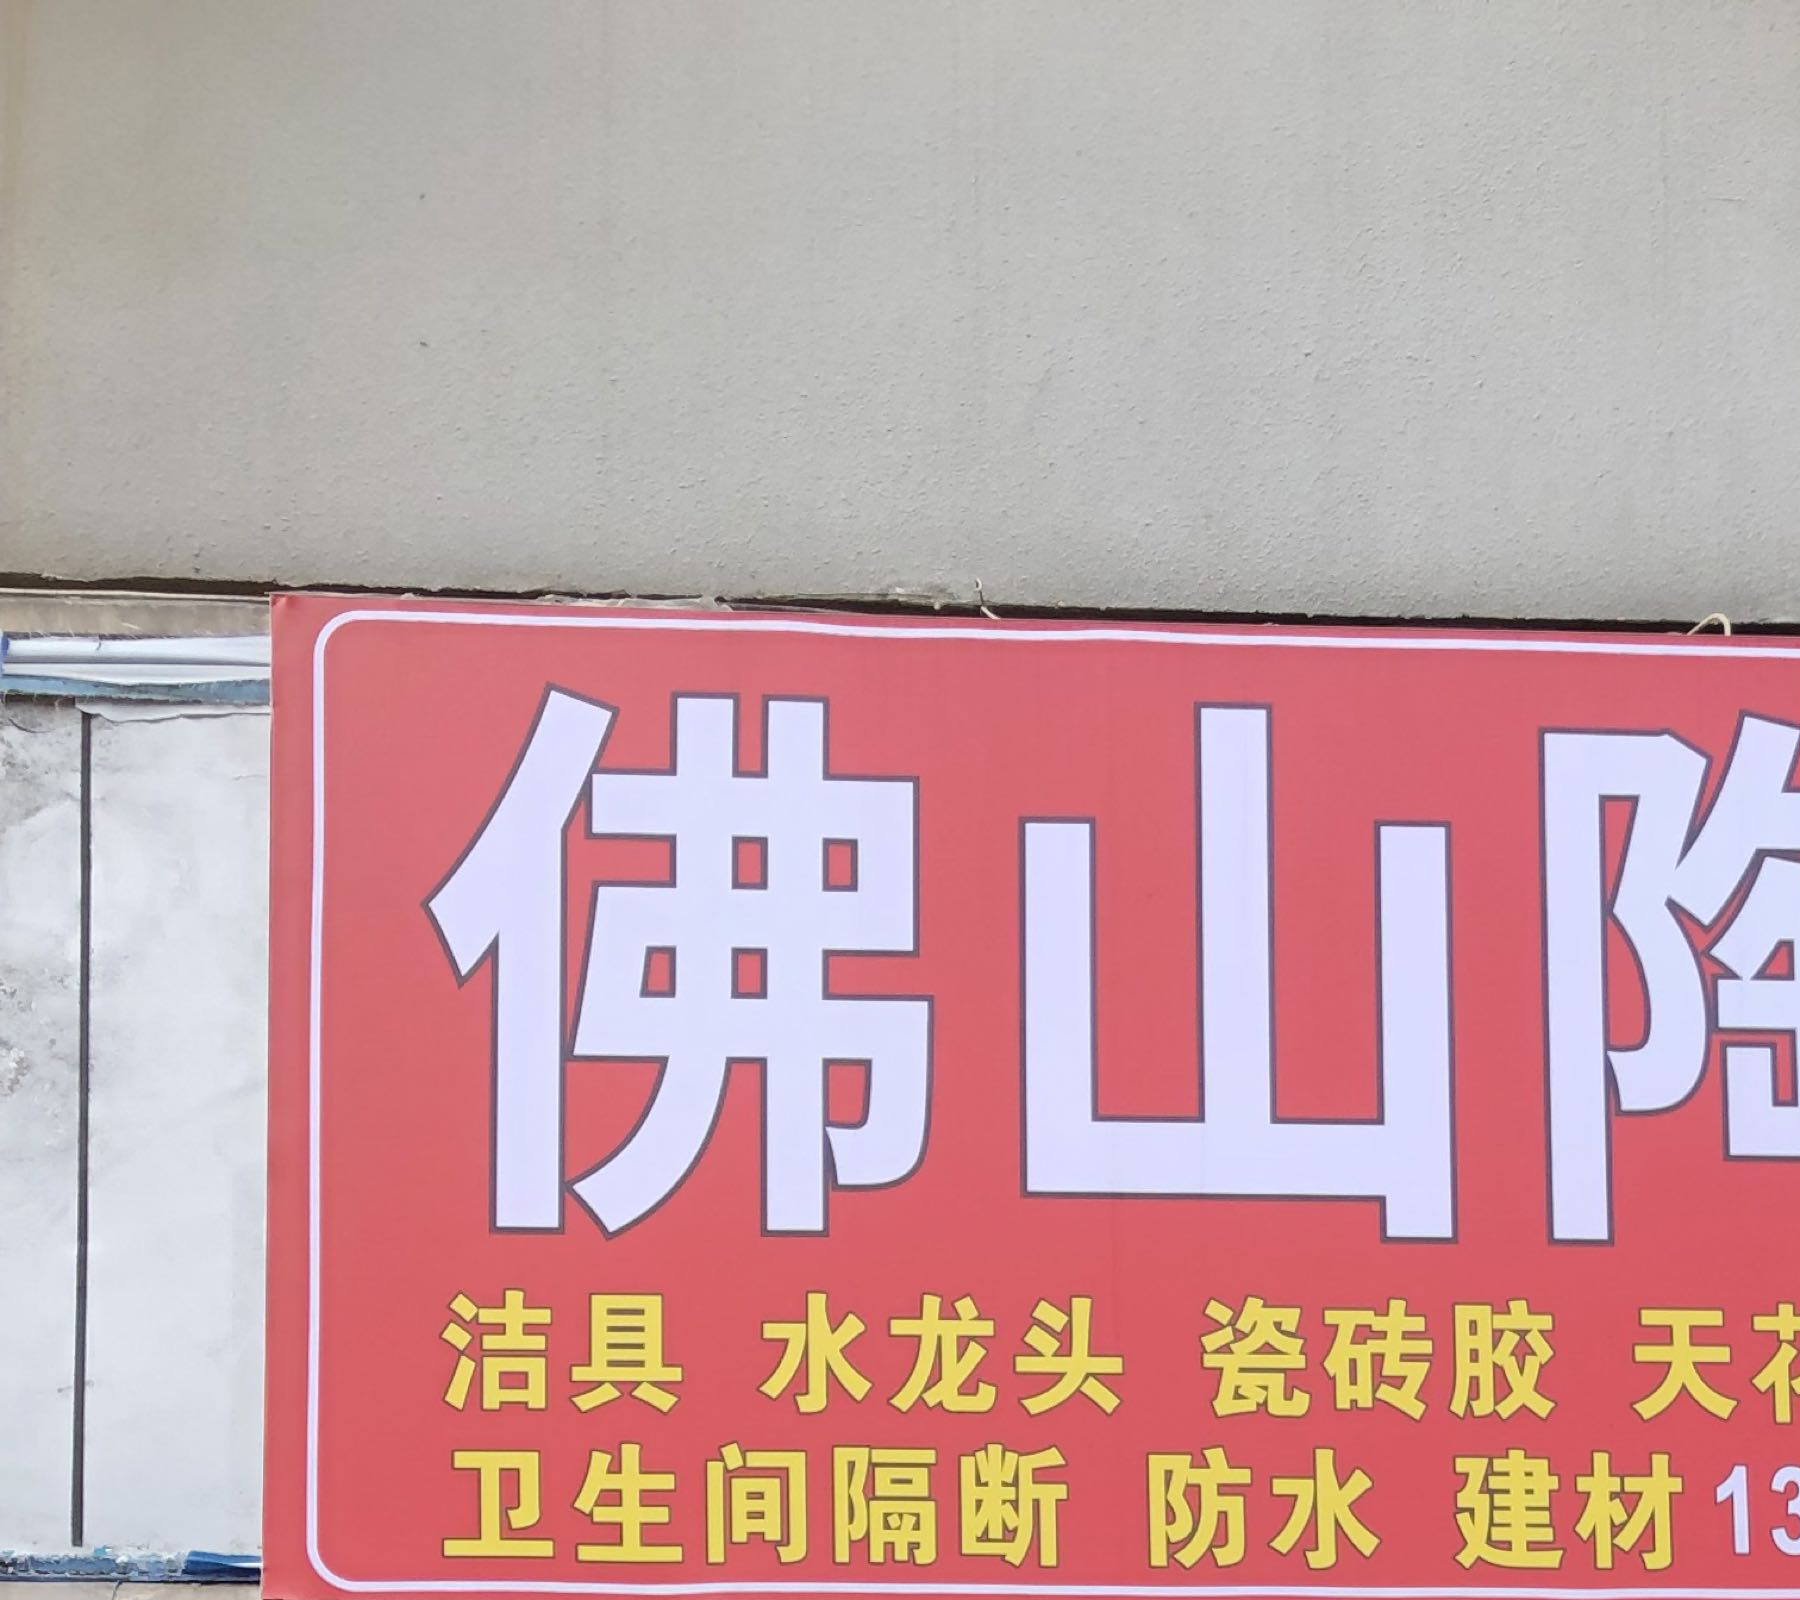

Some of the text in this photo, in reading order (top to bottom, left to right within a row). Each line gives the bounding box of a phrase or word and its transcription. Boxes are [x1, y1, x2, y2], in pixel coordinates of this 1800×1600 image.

[441, 1290, 684, 1413] 洁具
[760, 1293, 1124, 1420] 水龙头
[1198, 1298, 1557, 1422] 瓷砖胶
[441, 1445, 1069, 1569] 卫生间隔断
[1147, 1447, 1380, 1571] 防水
[1454, 1450, 1683, 1573] 建材
